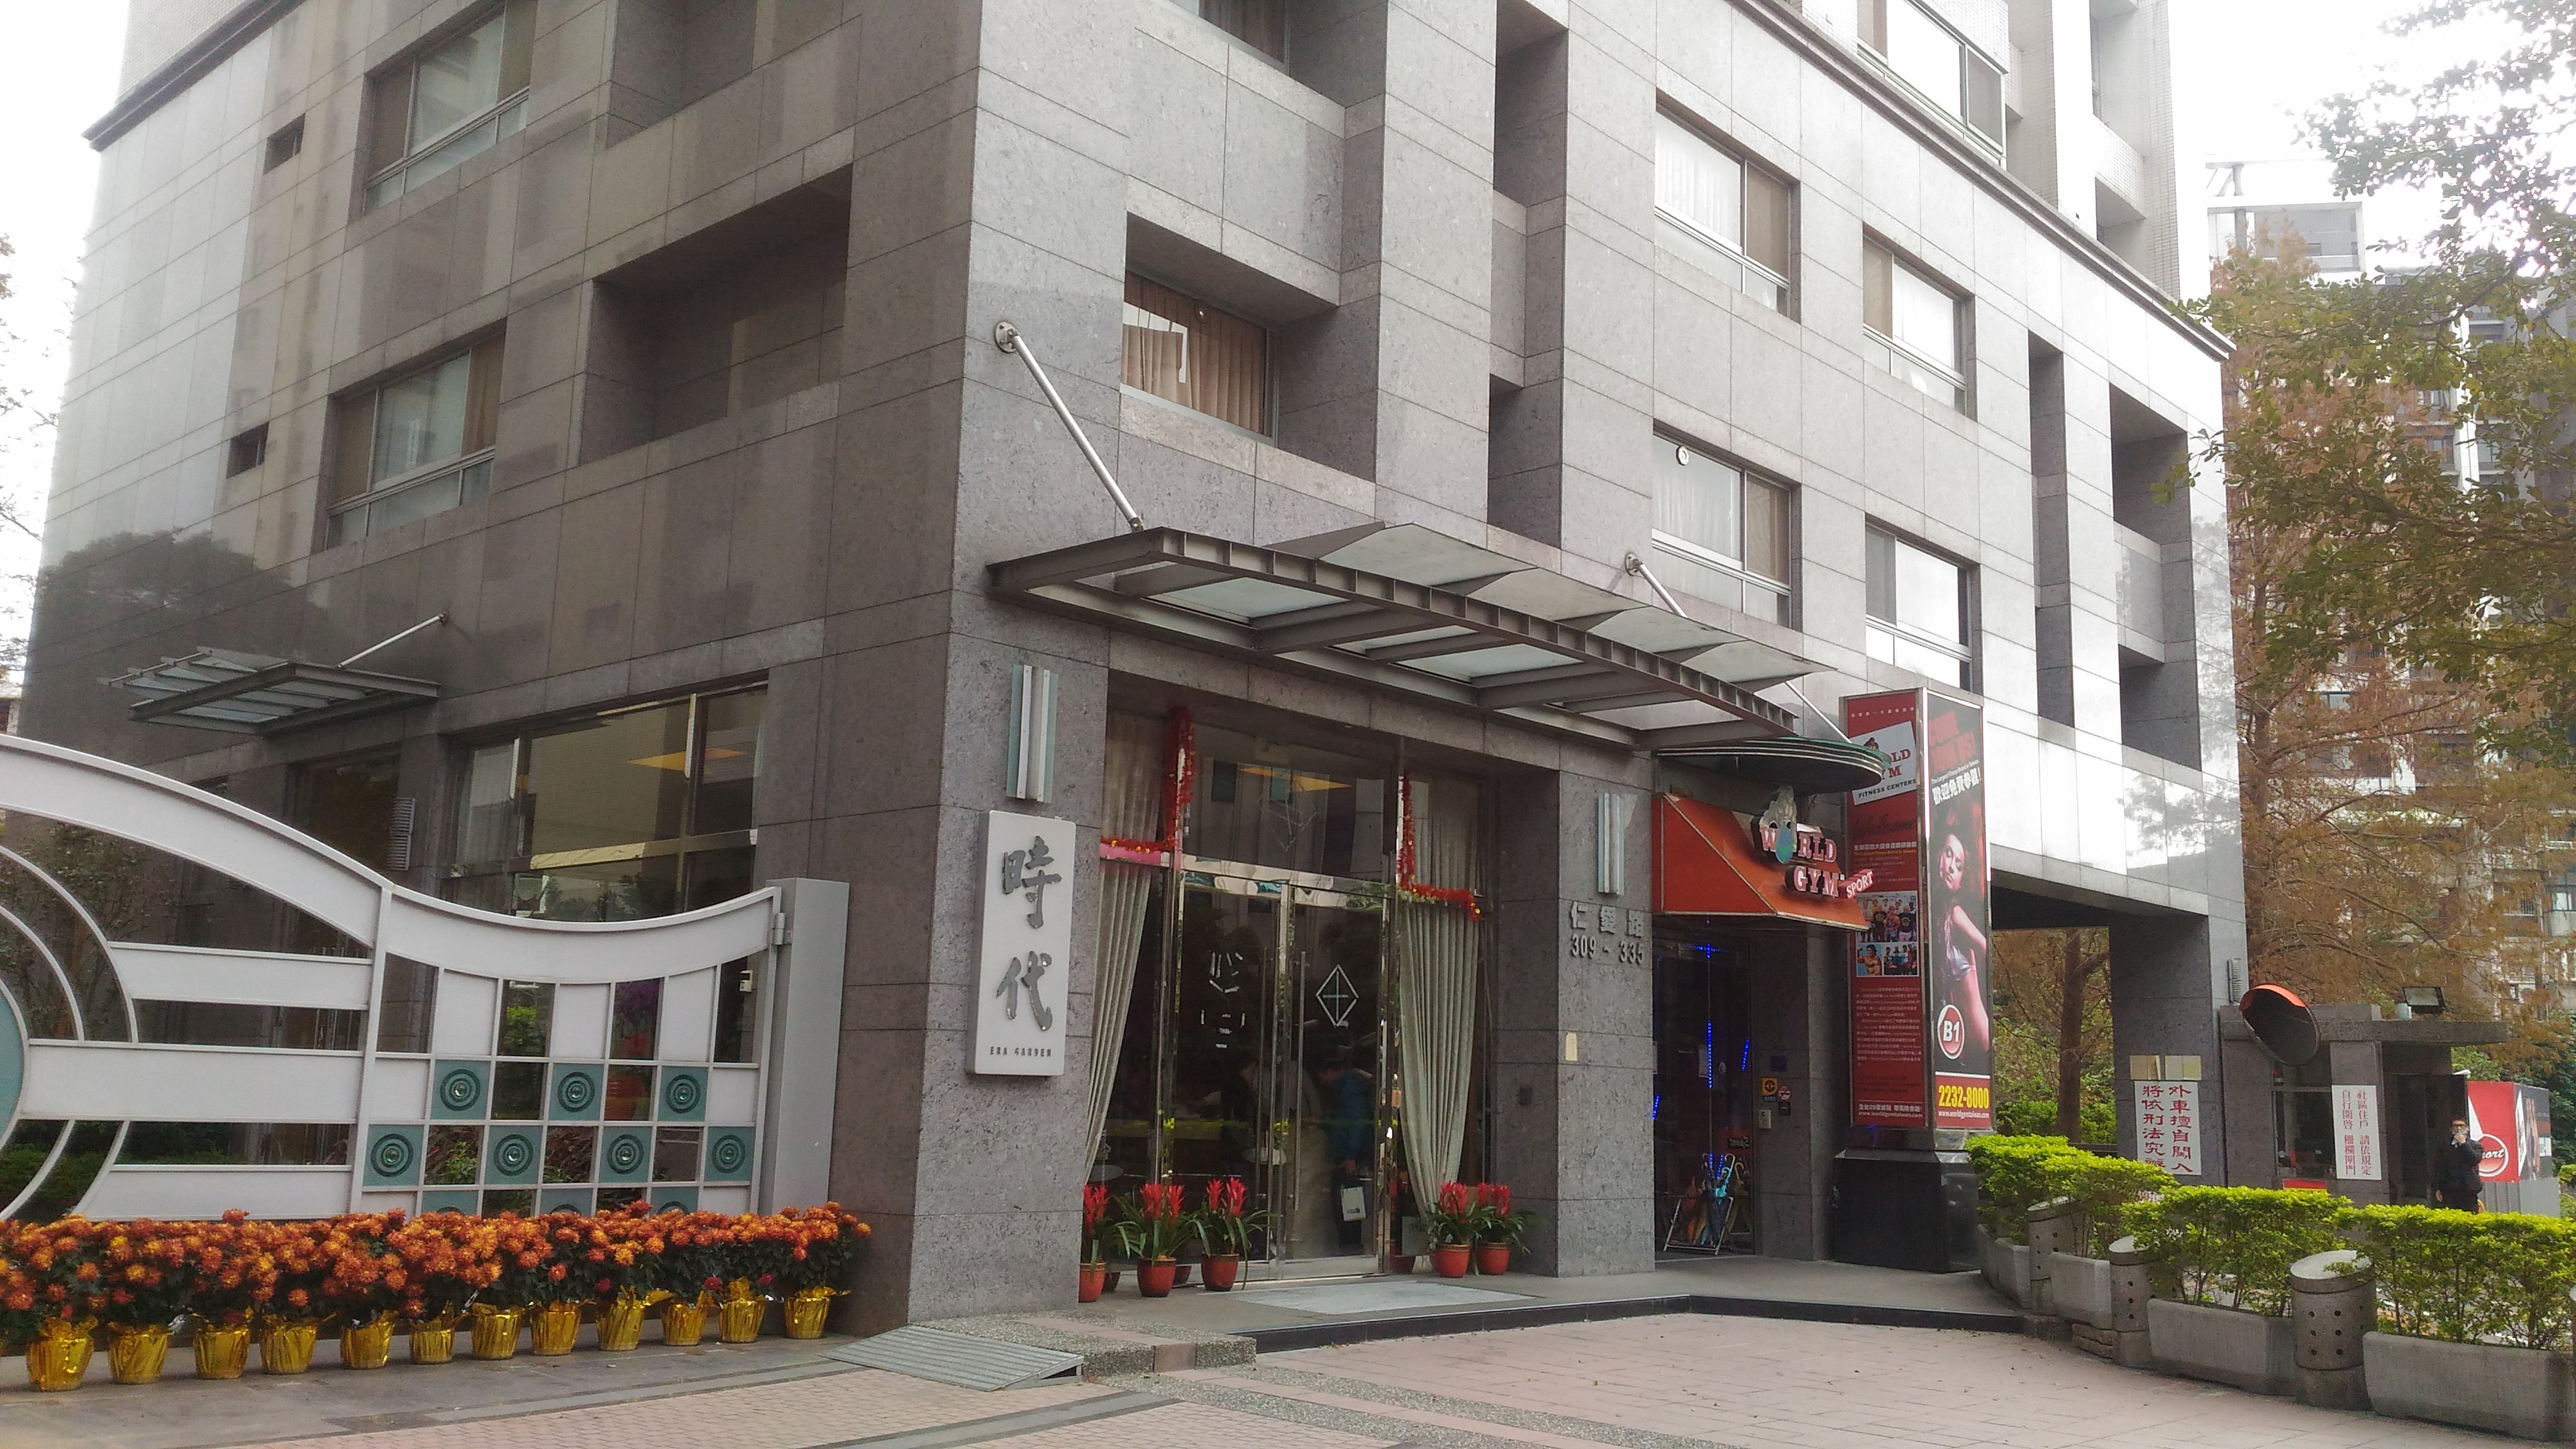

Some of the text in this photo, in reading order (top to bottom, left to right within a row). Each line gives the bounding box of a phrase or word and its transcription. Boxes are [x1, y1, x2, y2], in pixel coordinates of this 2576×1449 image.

[1858, 779, 1916, 798] FITNESS CENTERS
[1794, 865, 1839, 897] GYM
[1846, 871, 1874, 898] SPORT
[1572, 901, 1644, 936] 仁愛路
[997, 835, 1062, 1031] 時代
[1572, 934, 1596, 957] 309
[1620, 941, 1644, 964] 335
[1943, 1020, 1960, 1043] B1
[990, 1046, 1052, 1057] ERA GARDEN
[1938, 1085, 1989, 1109] 2232-8000
[2169, 1085, 2193, 1172] 外車擅自闖入
[2360, 1135, 2371, 1175] 請依規定
[2482, 1148, 2504, 1159] ort
